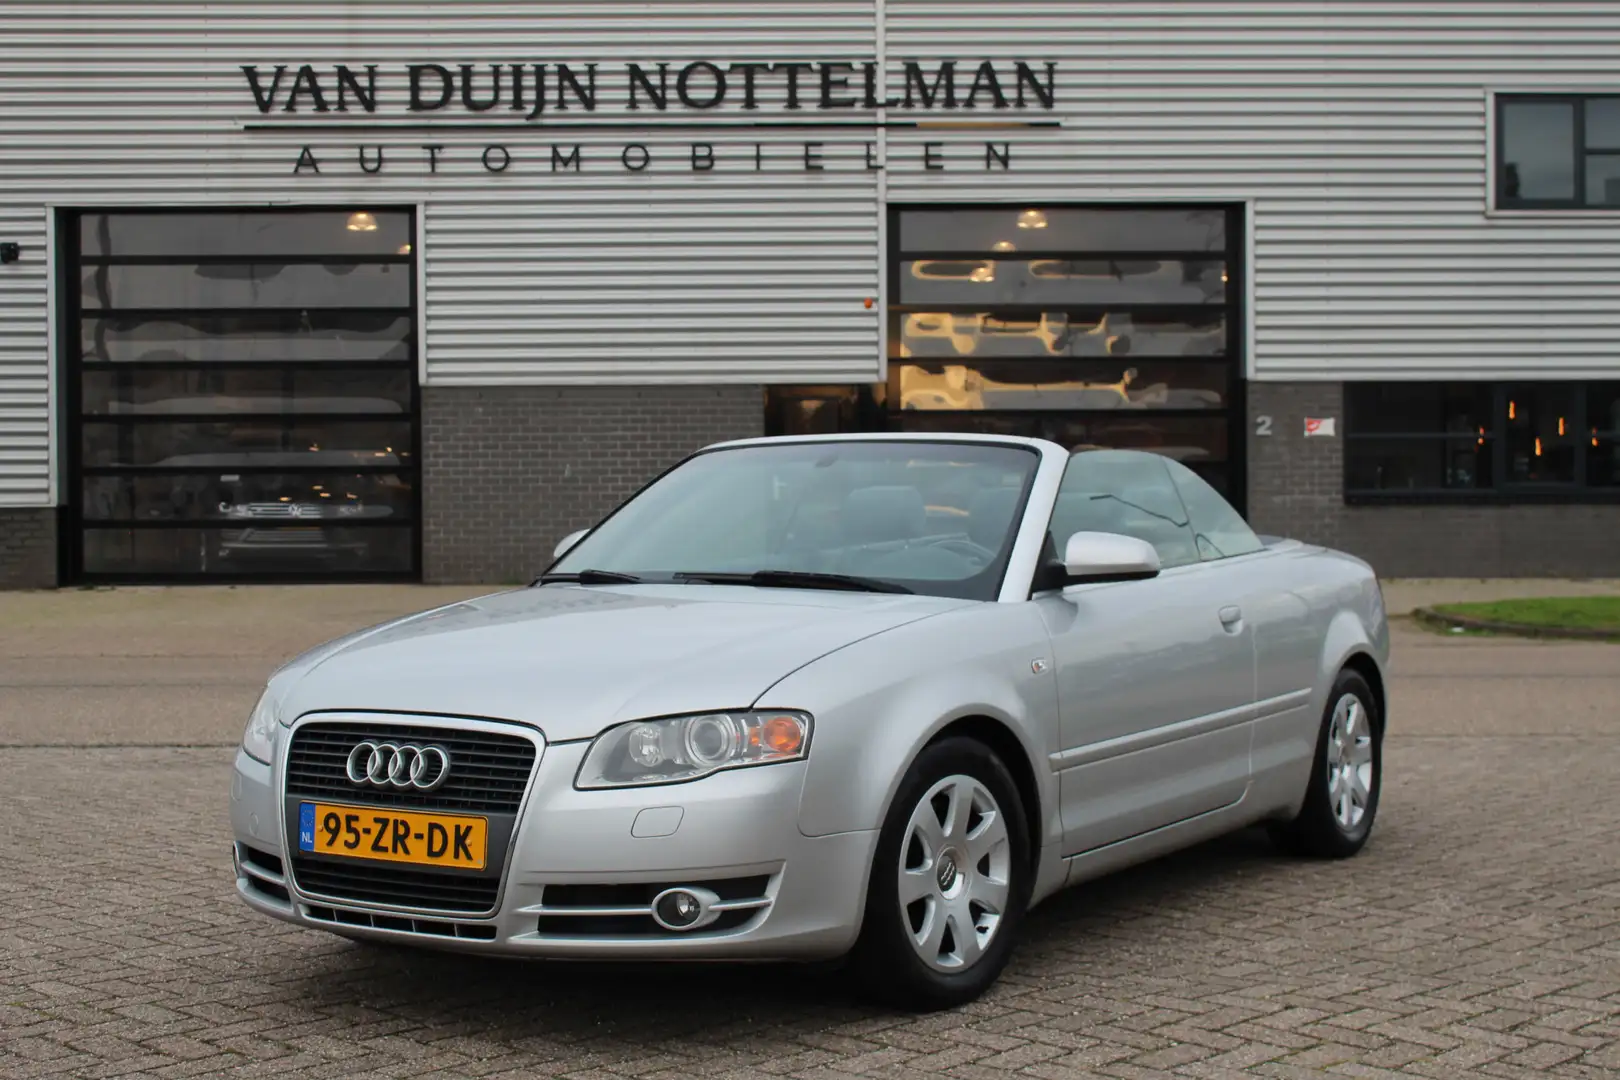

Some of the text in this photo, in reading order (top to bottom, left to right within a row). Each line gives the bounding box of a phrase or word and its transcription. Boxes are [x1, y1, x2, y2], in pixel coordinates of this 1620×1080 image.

[239, 61, 1059, 121] VAN DUIJN NOTTELMAN
[293, 142, 1011, 174] AUTOMOBIELEN
[1256, 415, 1272, 435] 2
[301, 812, 473, 861] NL 95-ZR-DK
